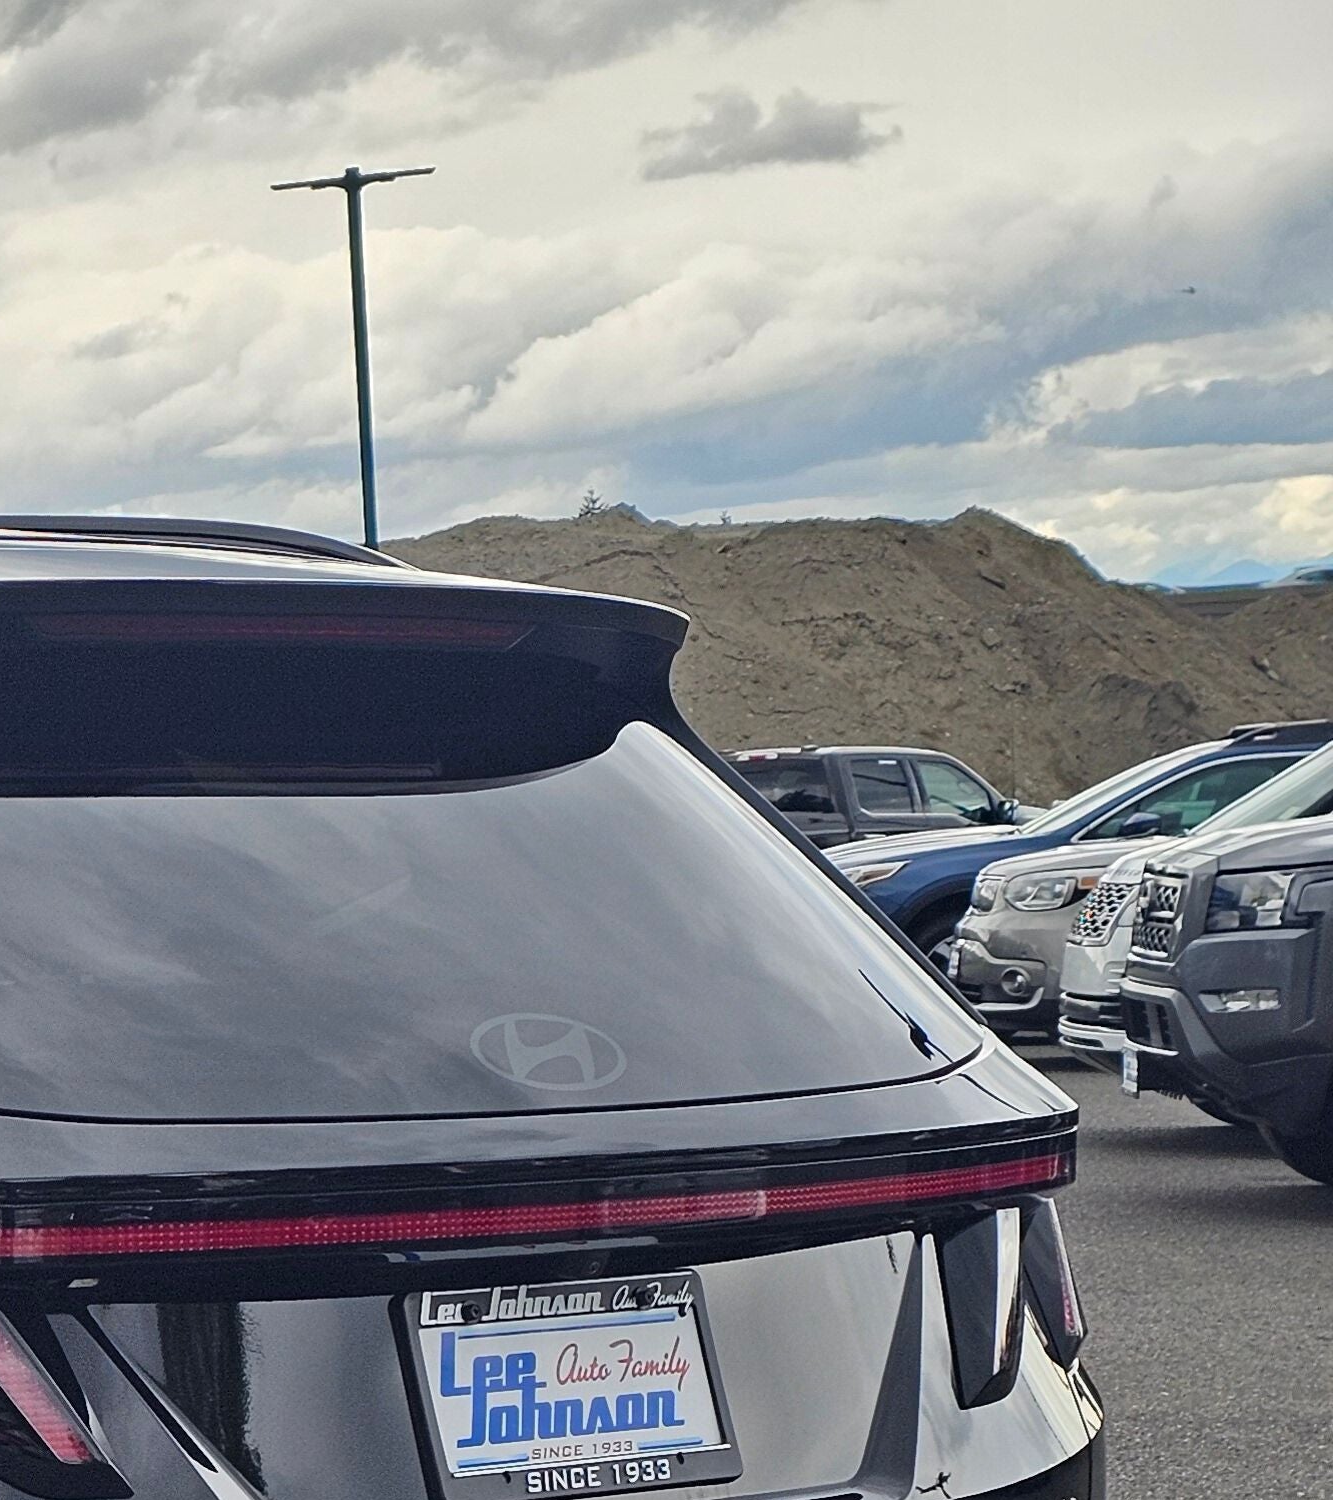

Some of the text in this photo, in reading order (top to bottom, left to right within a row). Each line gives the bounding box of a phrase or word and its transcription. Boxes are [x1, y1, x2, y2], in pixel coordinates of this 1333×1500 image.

[481, 1285, 605, 1321] Johnson
[647, 1280, 695, 1312] Family
[440, 1332, 546, 1397] Lee
[556, 1336, 690, 1391] Auto Family
[457, 1380, 685, 1448] Johnson
[531, 1440, 633, 1460] SINCE 1933
[527, 1458, 671, 1493] SINCE 1933
